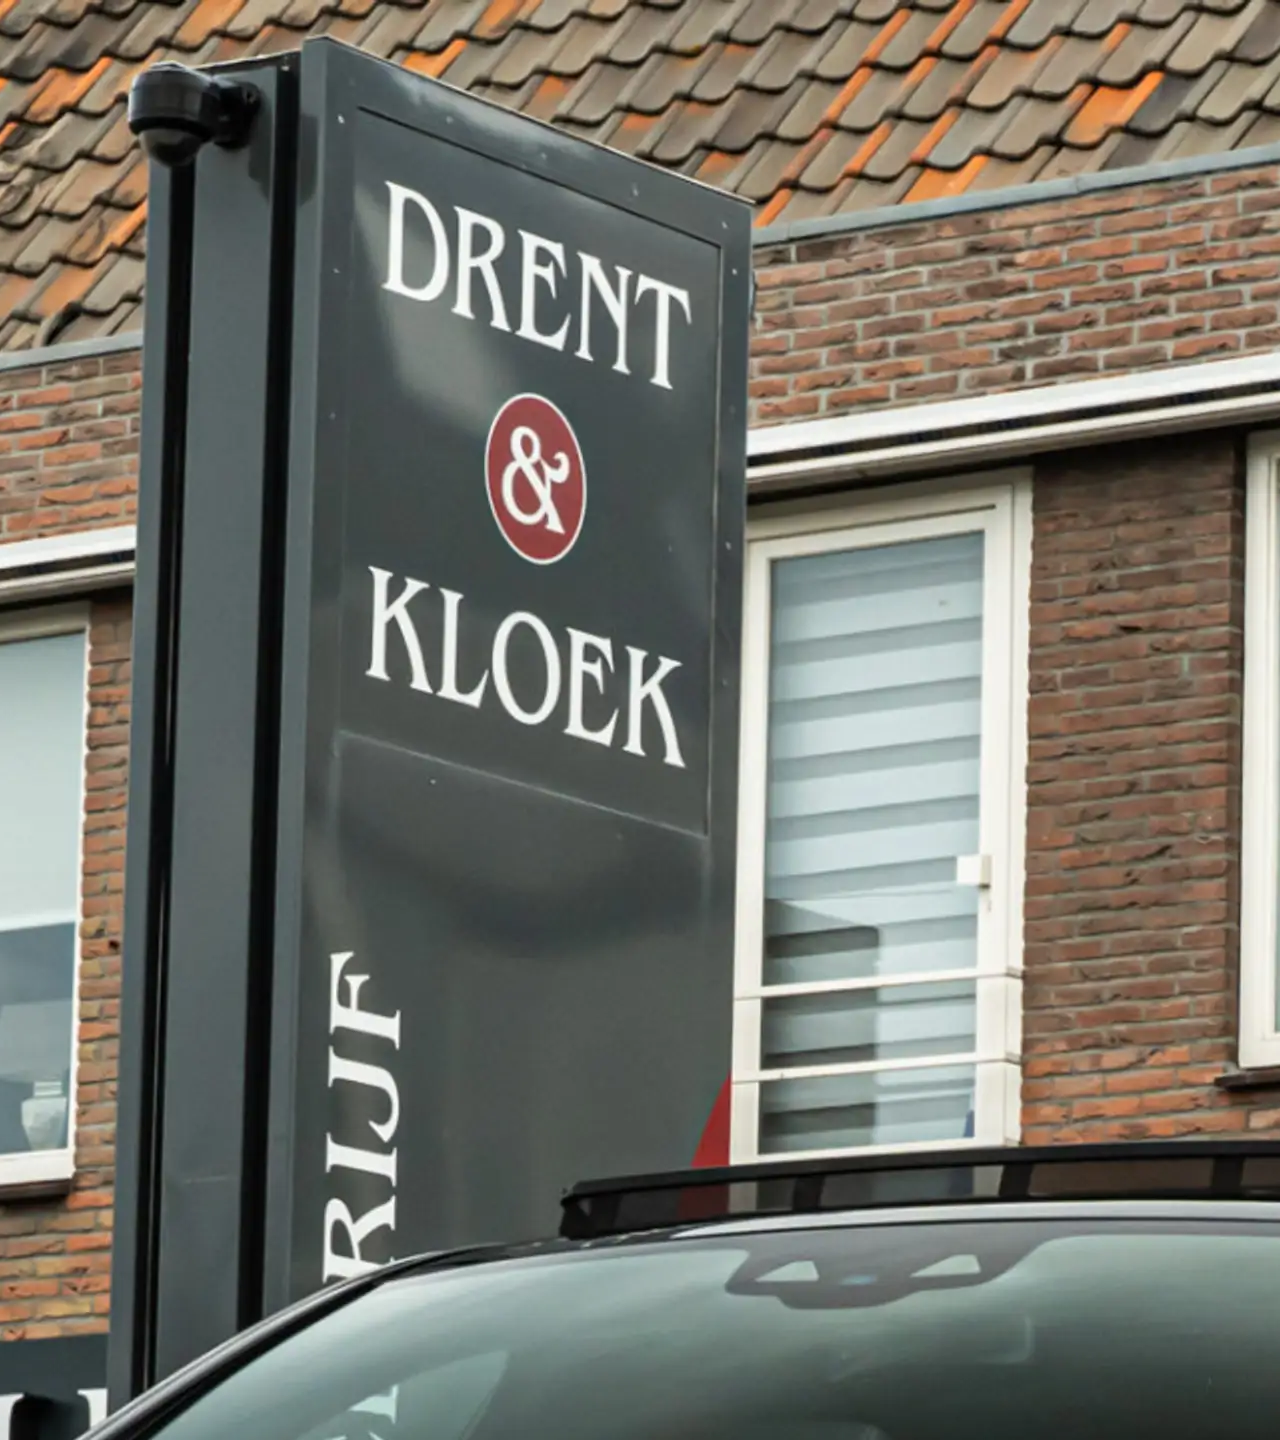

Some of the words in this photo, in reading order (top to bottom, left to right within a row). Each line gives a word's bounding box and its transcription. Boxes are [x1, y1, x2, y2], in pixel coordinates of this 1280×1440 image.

[381, 180, 692, 390] DRENT
[501, 425, 570, 534] &
[365, 565, 686, 768] KLOEK
